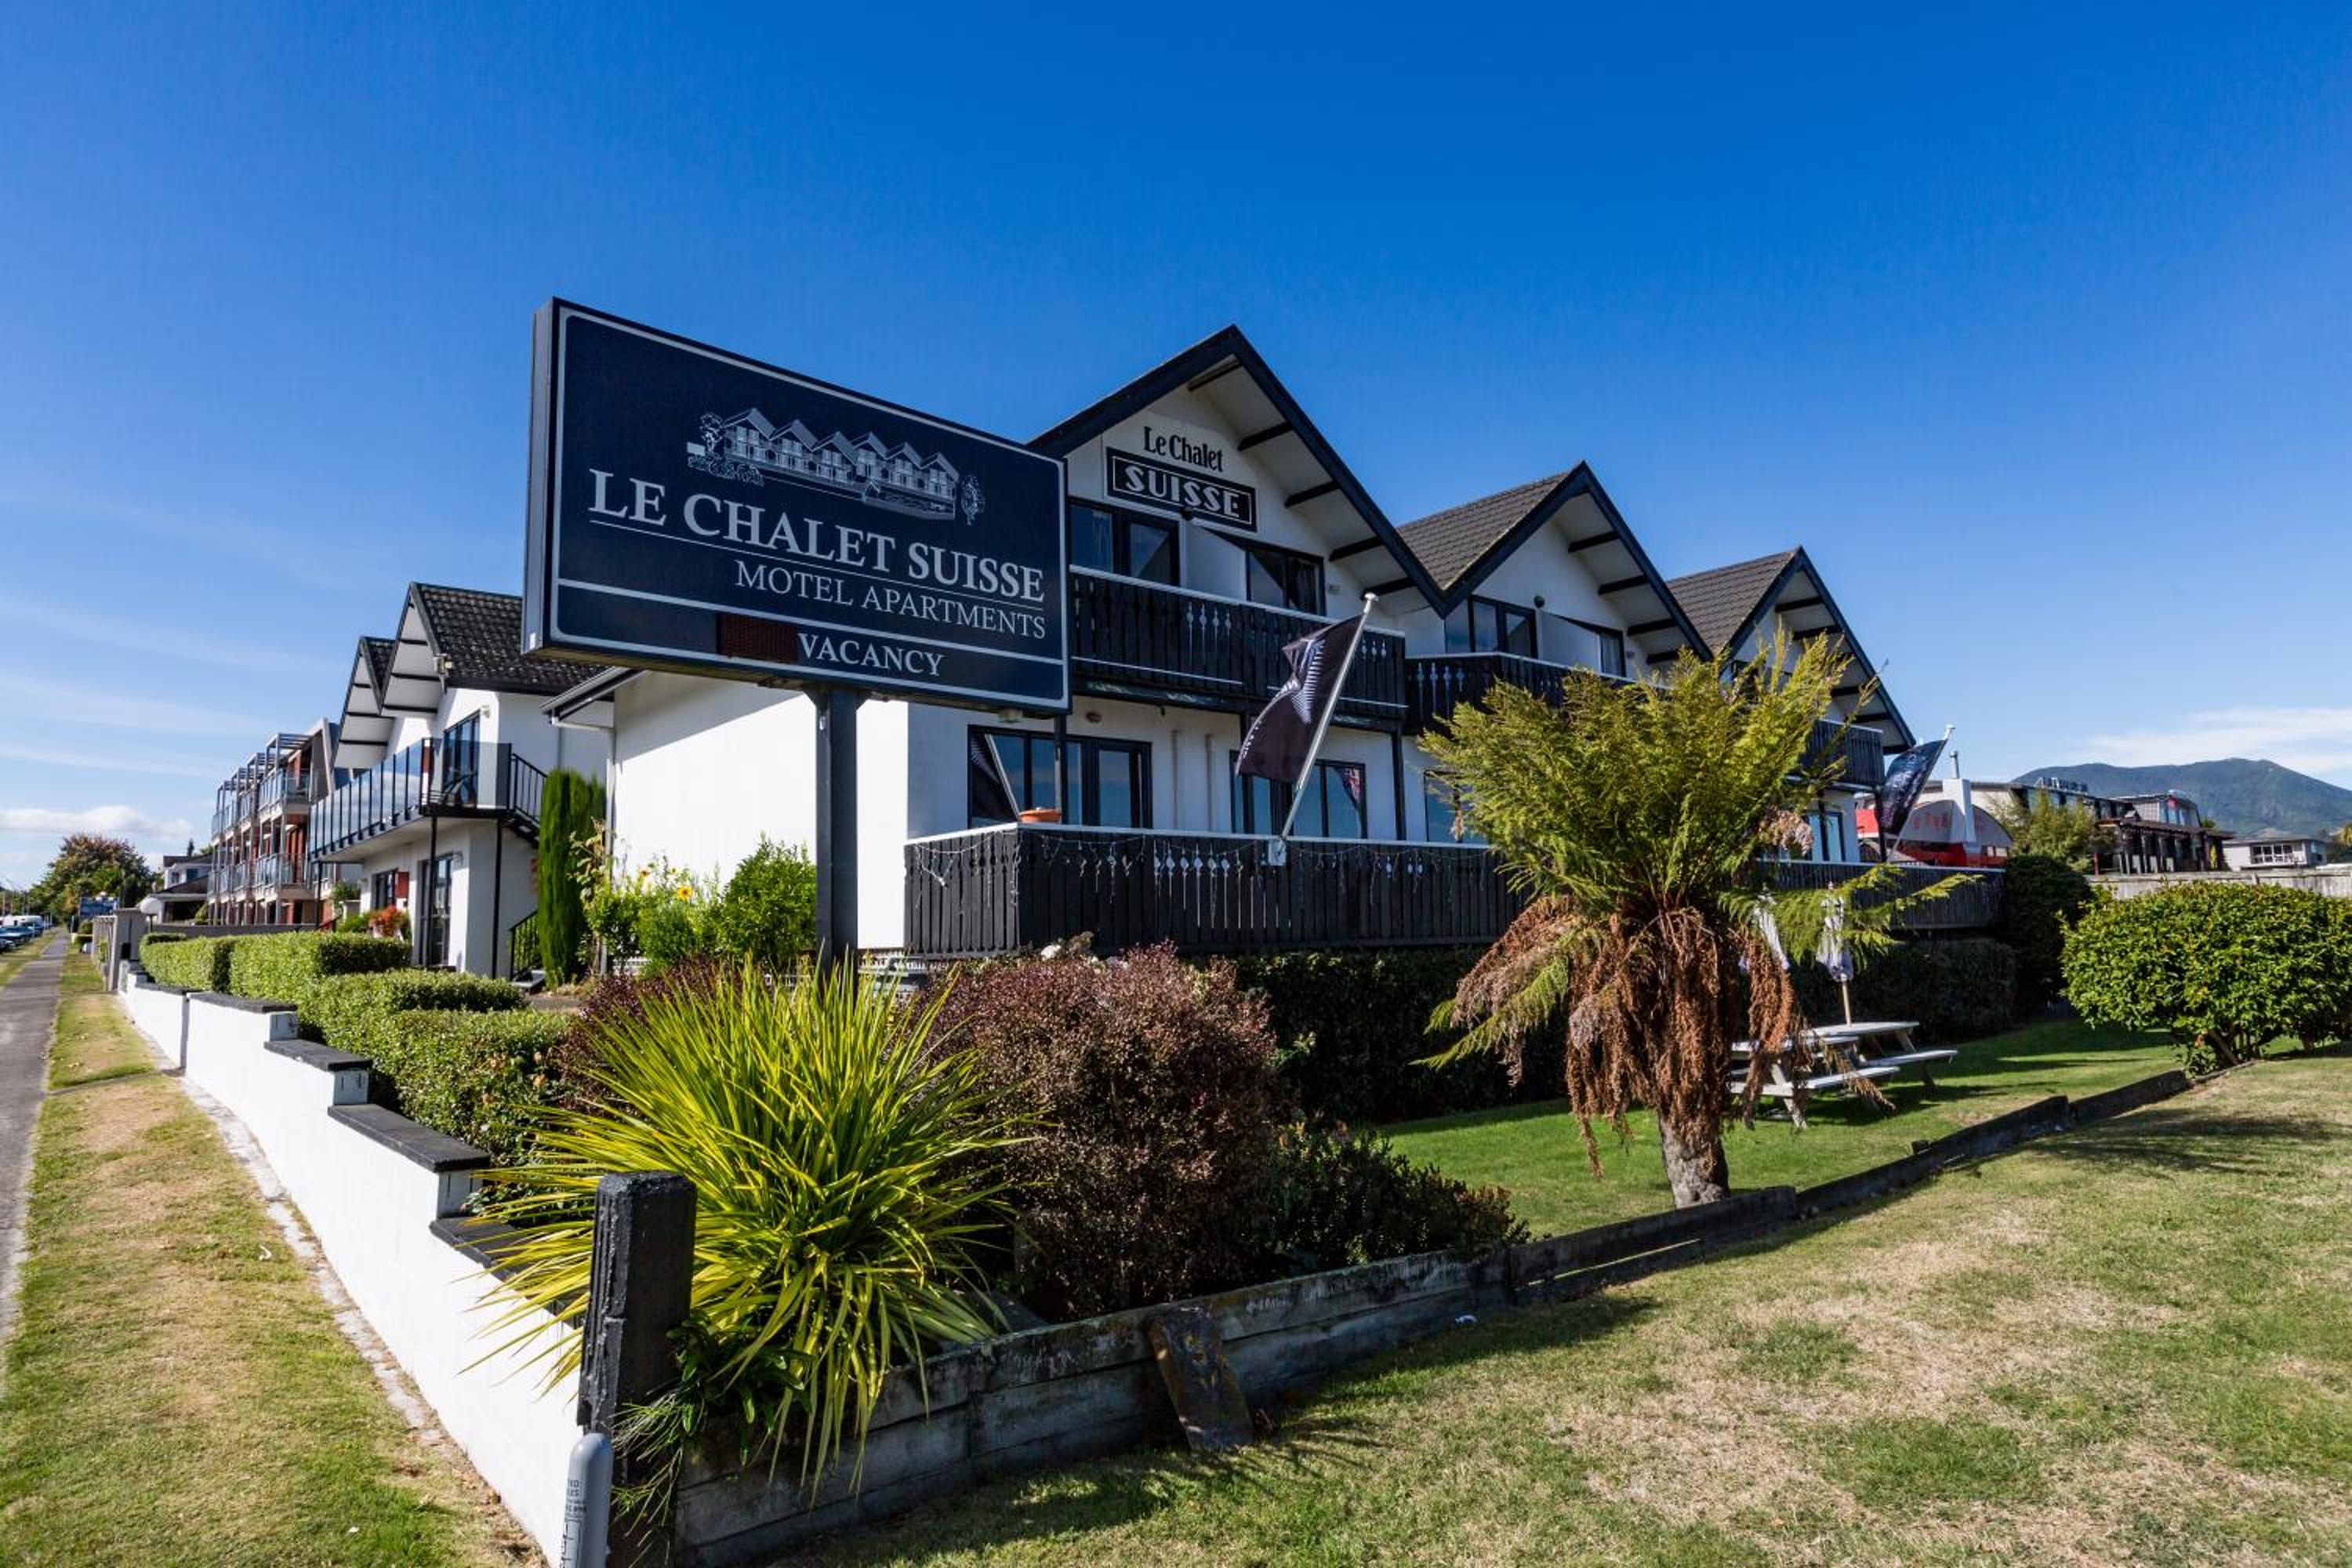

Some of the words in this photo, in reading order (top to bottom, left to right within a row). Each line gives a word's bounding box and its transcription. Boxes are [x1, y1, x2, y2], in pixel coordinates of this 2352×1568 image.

[1144, 426, 1167, 456] Le
[1169, 434, 1224, 473] Chalet
[1124, 465, 1241, 518] SUISSE
[589, 468, 666, 526] LE
[683, 493, 896, 572] CHALET
[908, 543, 1044, 603] SUISSE
[734, 560, 853, 606] MOTEL
[862, 586, 1046, 639] APARTMENTS
[797, 633, 945, 676] VACANCY
